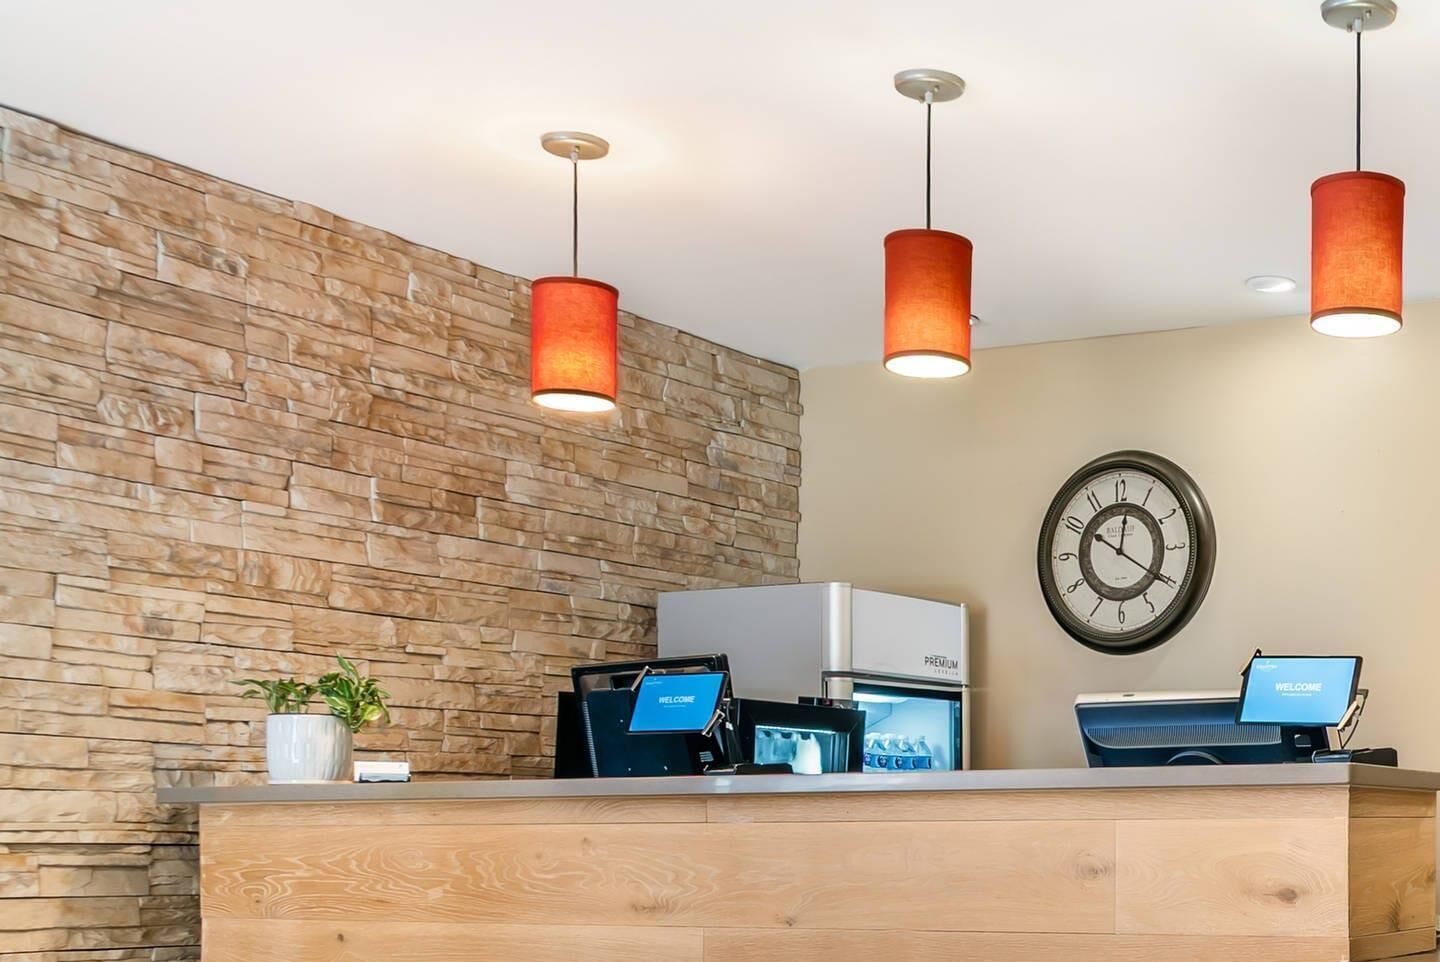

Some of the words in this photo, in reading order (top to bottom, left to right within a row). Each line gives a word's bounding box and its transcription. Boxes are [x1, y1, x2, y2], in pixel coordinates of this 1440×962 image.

[1115, 479, 1128, 503] 12
[1142, 486, 1154, 507] 1
[1087, 489, 1103, 513] 11
[1065, 516, 1085, 535] 10
[1158, 508, 1177, 525] 2
[1165, 542, 1186, 551] 3
[1058, 552, 1079, 562] 9
[1066, 578, 1085, 594] 8
[1089, 596, 1104, 617] 7
[1118, 600, 1126, 624] 6
[1143, 592, 1155, 614] 5
[924, 656, 959, 669] PREMIUM
[1275, 682, 1323, 692] WELCOME
[658, 695, 696, 704] WELCOME
